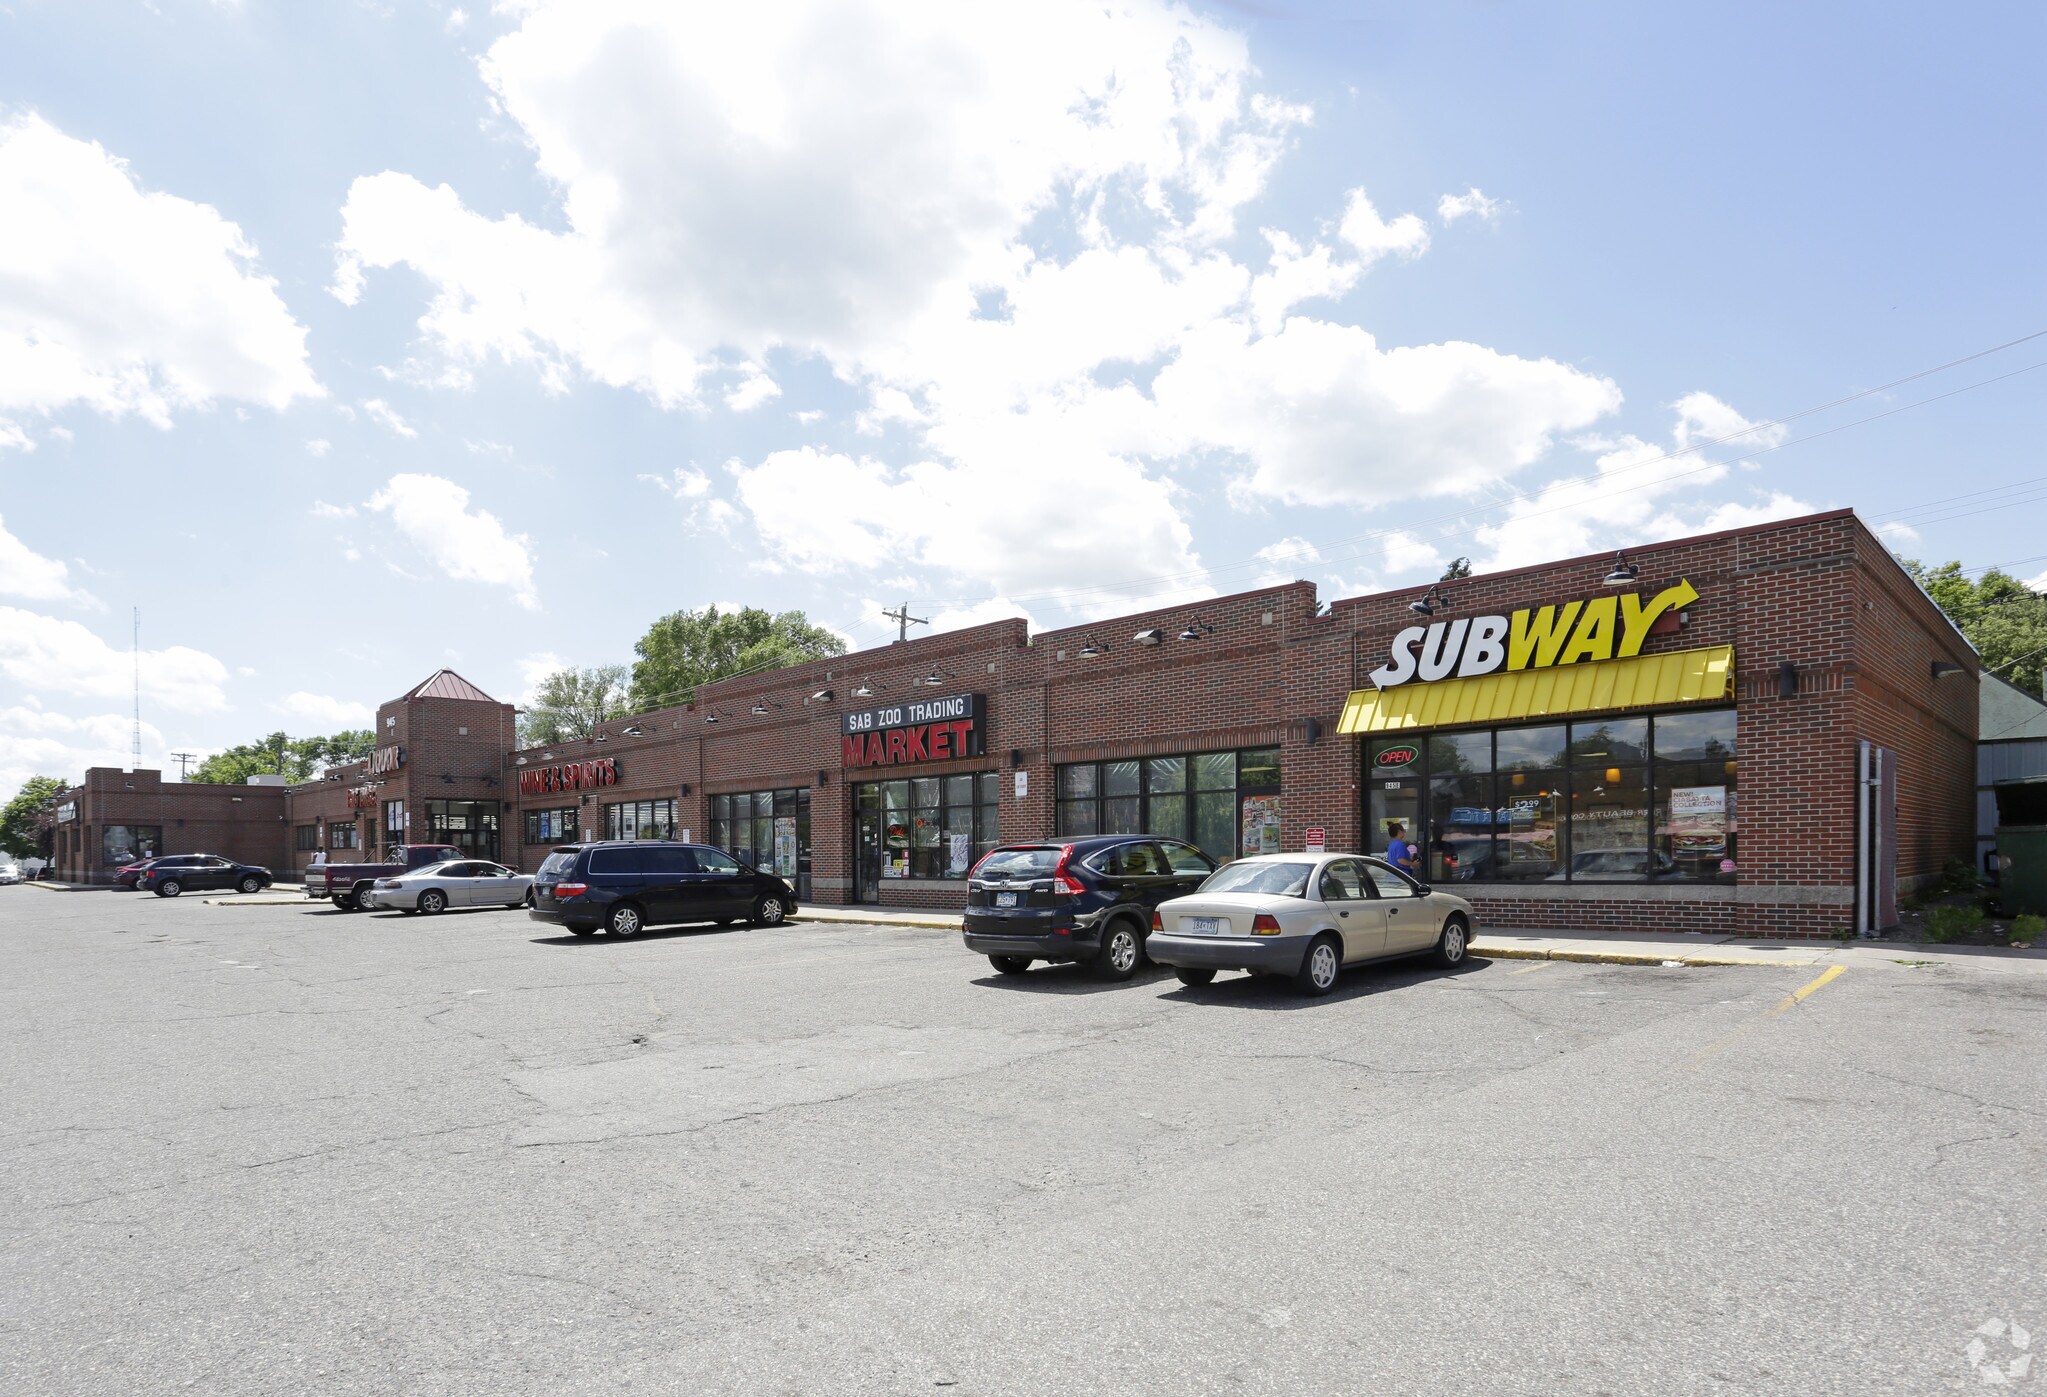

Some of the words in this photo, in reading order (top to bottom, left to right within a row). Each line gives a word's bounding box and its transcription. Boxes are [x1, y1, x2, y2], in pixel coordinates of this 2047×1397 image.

[1369, 578, 1700, 691] SUBWAY
[849, 713, 872, 730] SAB
[878, 708, 901, 726] ZOO
[908, 698, 964, 721] TRADING
[367, 746, 399, 775] LIQUOR
[842, 720, 973, 768] MARKET
[1380, 750, 1412, 763] OPEN
[520, 768, 549, 795] WINE
[551, 766, 560, 792] &
[563, 758, 615, 790] SPIRITS
